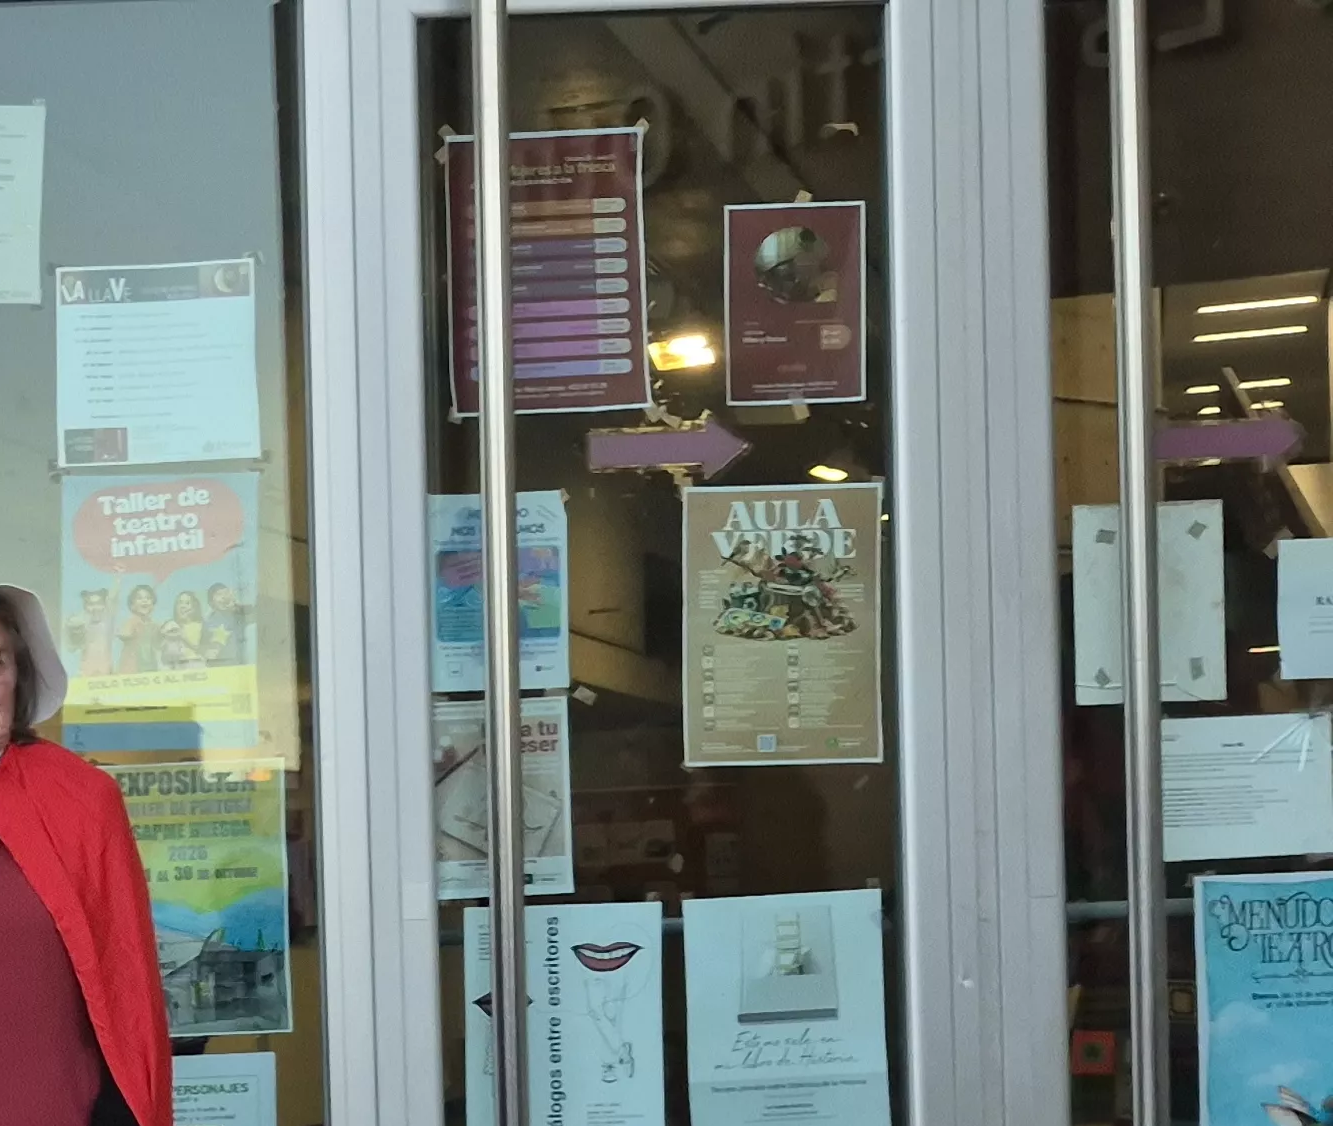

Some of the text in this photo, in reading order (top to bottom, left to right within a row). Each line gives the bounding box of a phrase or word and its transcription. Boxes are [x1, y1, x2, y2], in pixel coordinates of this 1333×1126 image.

[97, 486, 211, 516] Taller de
[722, 498, 842, 531] AULA
[113, 512, 199, 536] teatro
[110, 529, 205, 559] infantil
[543, 915, 562, 1007] escritores
[547, 1015, 563, 1064] entre
